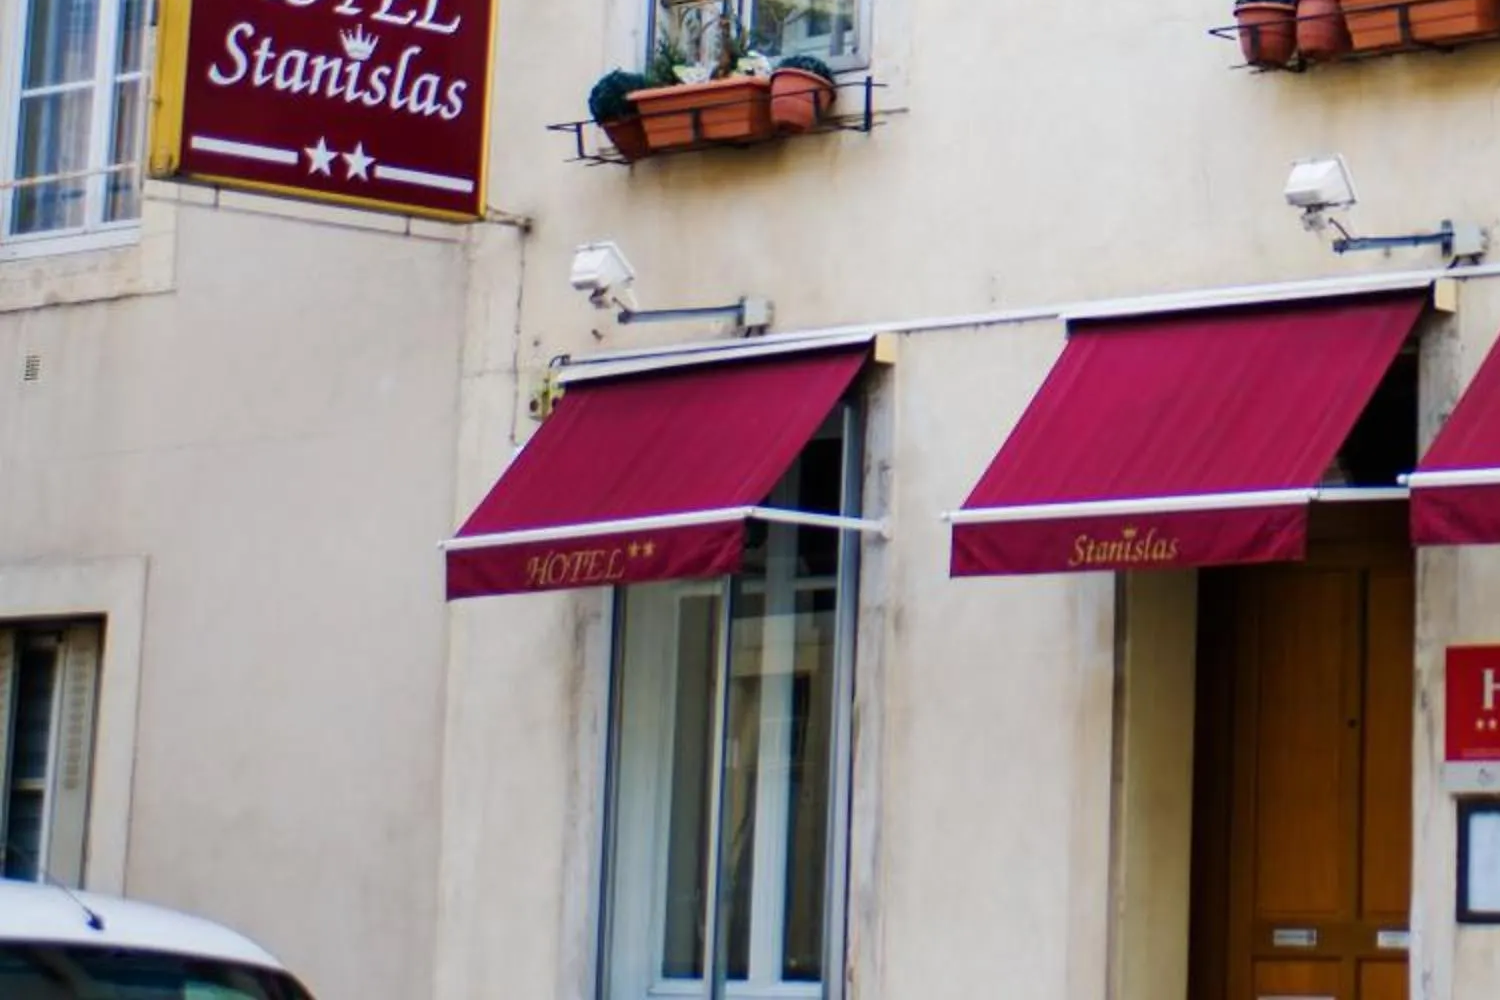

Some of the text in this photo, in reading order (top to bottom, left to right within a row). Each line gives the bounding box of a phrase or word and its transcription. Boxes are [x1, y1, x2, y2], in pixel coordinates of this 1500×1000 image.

[208, 22, 468, 120] Stanislas
[1068, 528, 1179, 566] Stanislas
[526, 549, 626, 586] HOTEL
